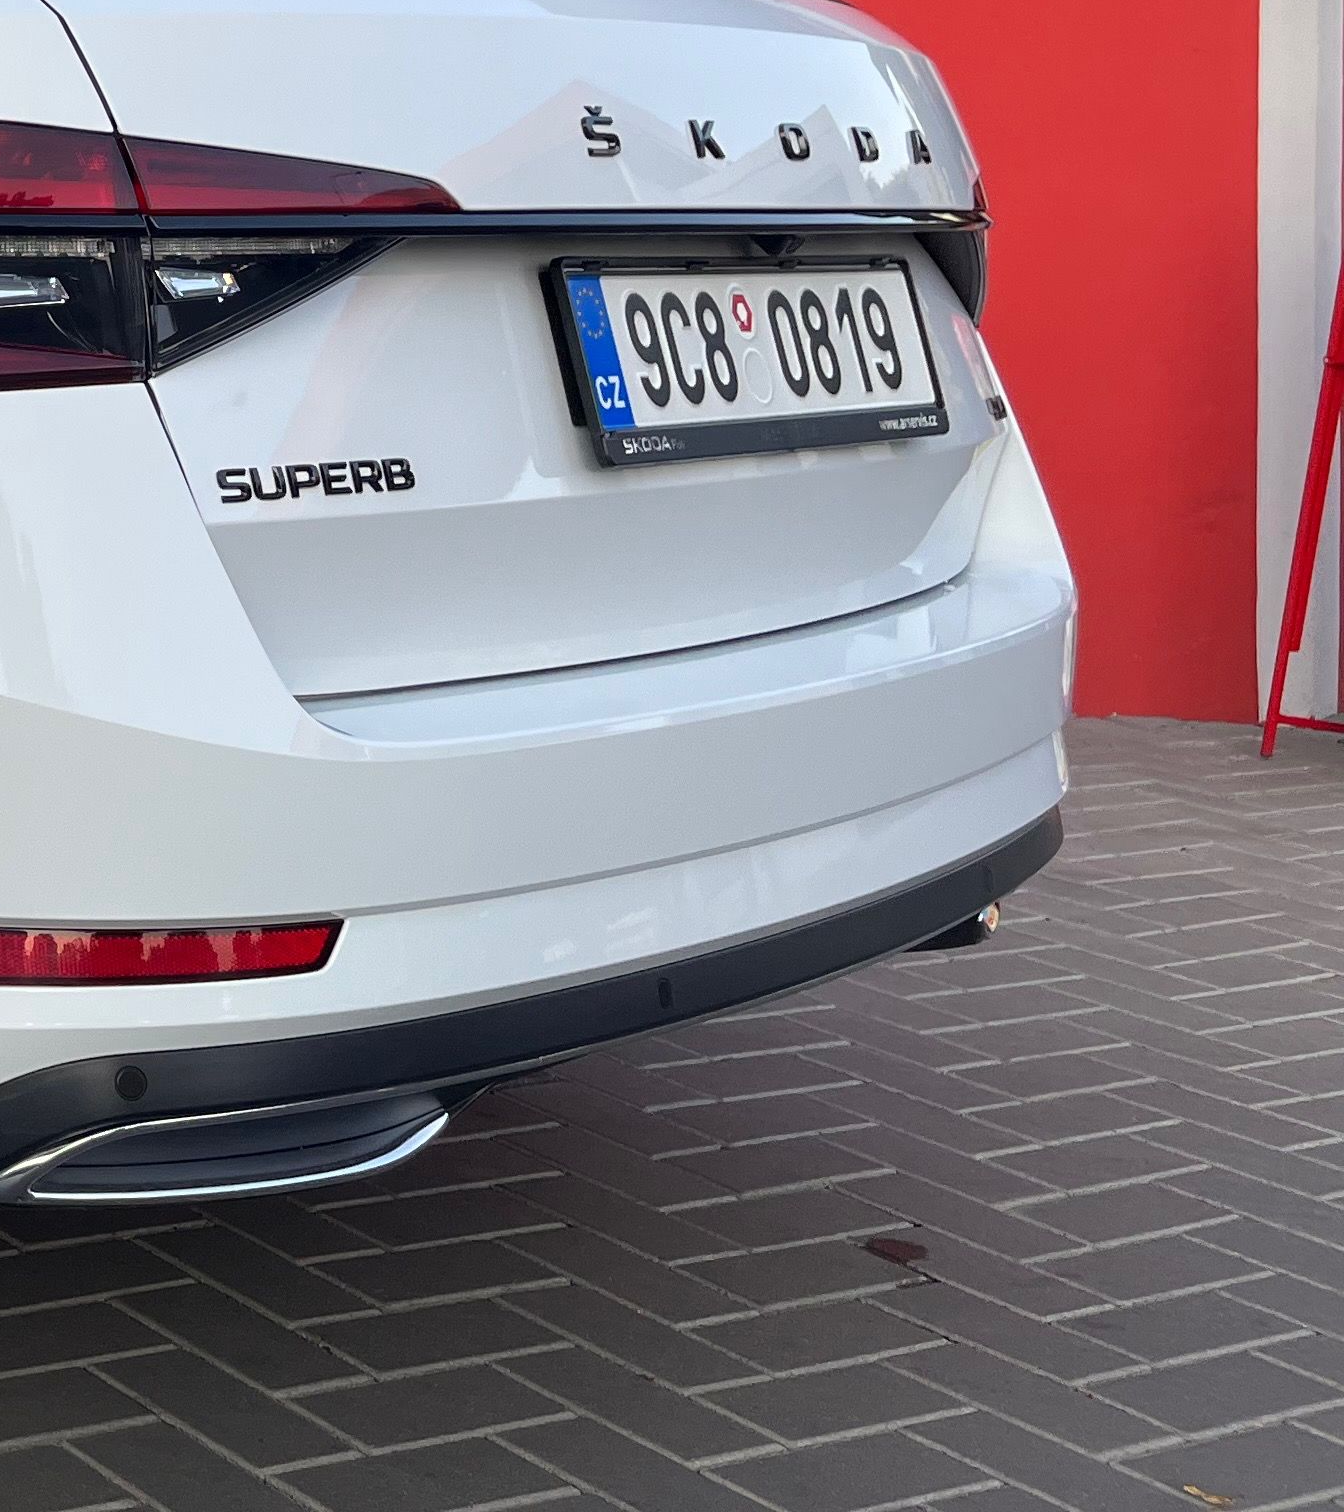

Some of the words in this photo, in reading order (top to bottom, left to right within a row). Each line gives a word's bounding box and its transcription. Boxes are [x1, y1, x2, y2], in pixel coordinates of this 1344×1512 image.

[580, 105, 933, 165] ŠKODA
[624, 290, 739, 409] 9C8
[767, 287, 903, 398] 0819
[595, 375, 626, 411] CZ
[216, 456, 416, 504] SUPERB
